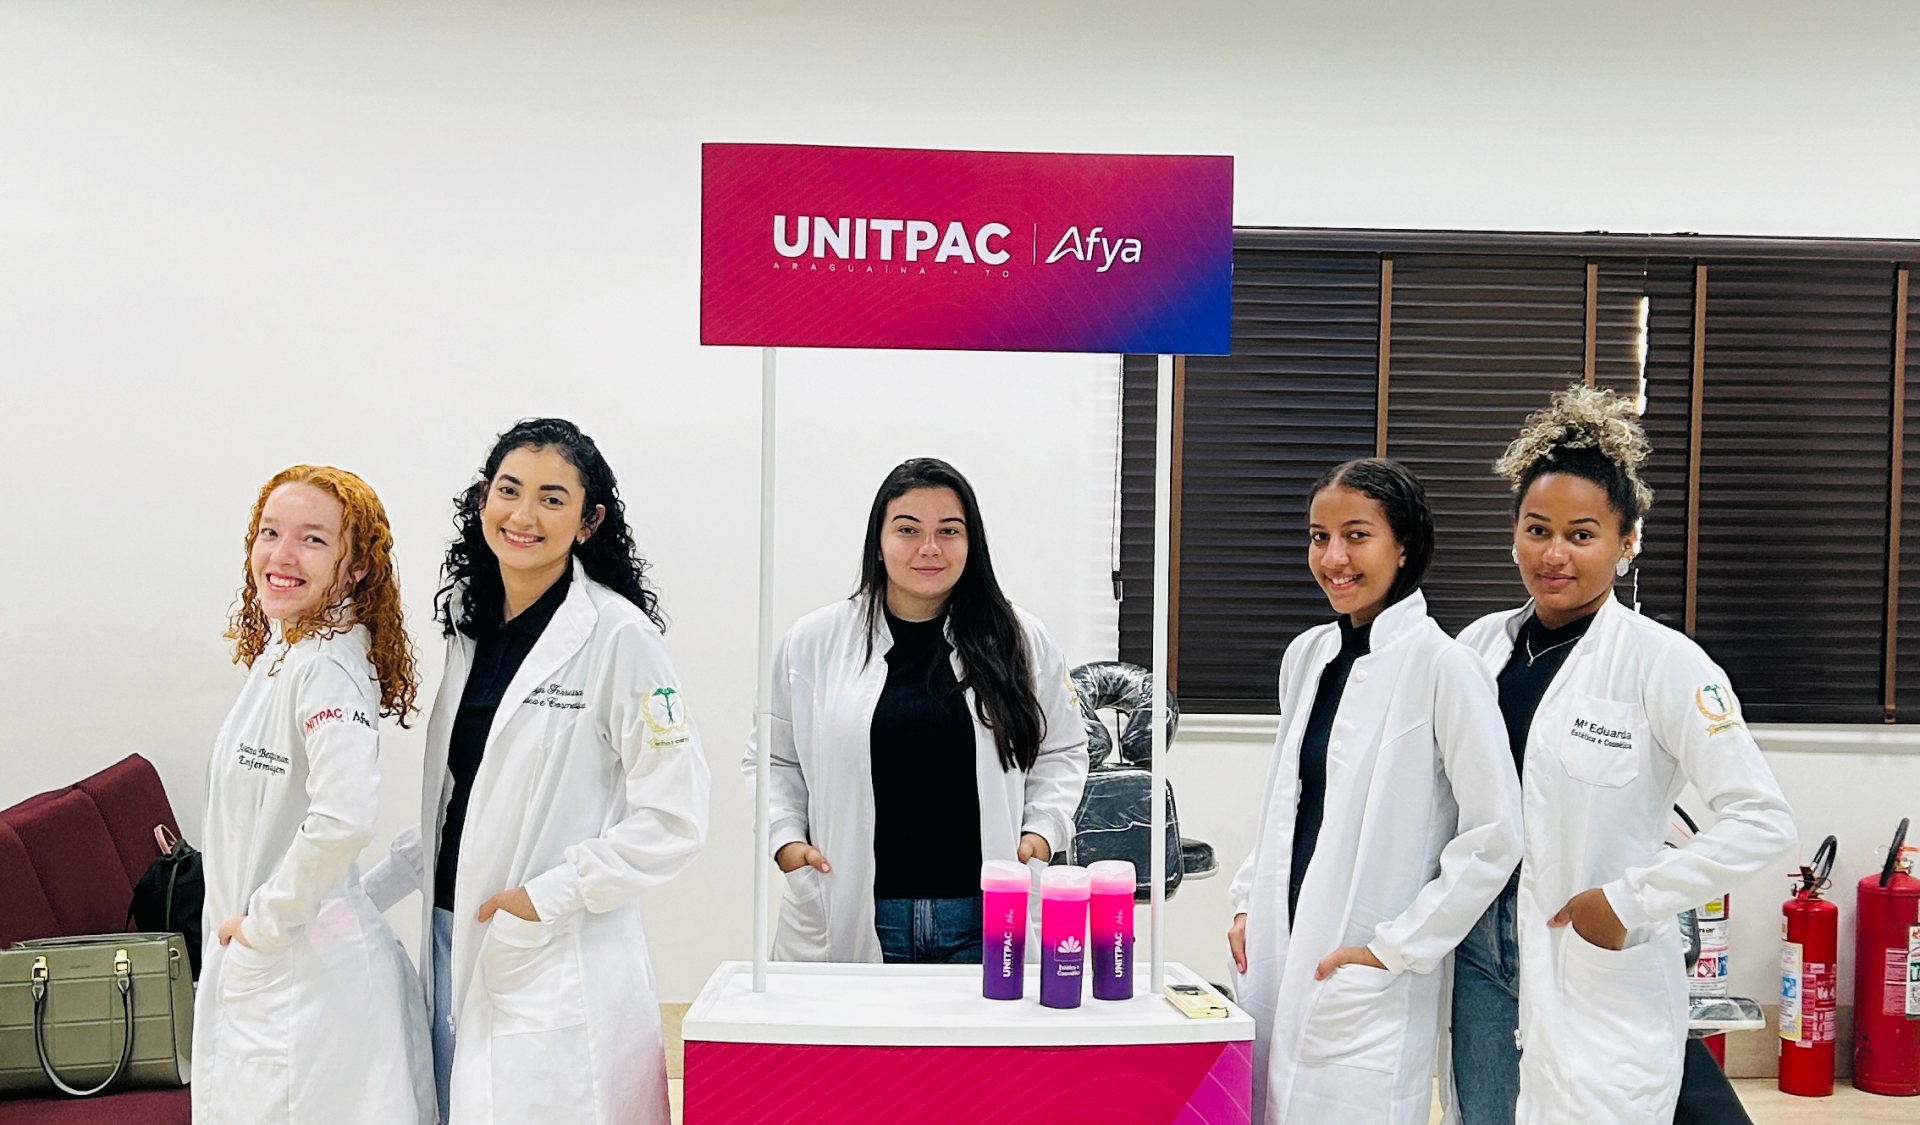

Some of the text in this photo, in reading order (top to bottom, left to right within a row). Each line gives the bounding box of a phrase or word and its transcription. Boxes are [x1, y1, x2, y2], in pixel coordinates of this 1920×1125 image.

[773, 214, 1142, 273] UNITPAC Afya
[773, 262, 1009, 278] ARAGUAÍNA TO
[304, 708, 343, 731] NITPAC
[1589, 723, 1632, 740] Eduarda
[1003, 931, 1013, 978] UNITPAC
[1114, 932, 1123, 978] UNITPAC
